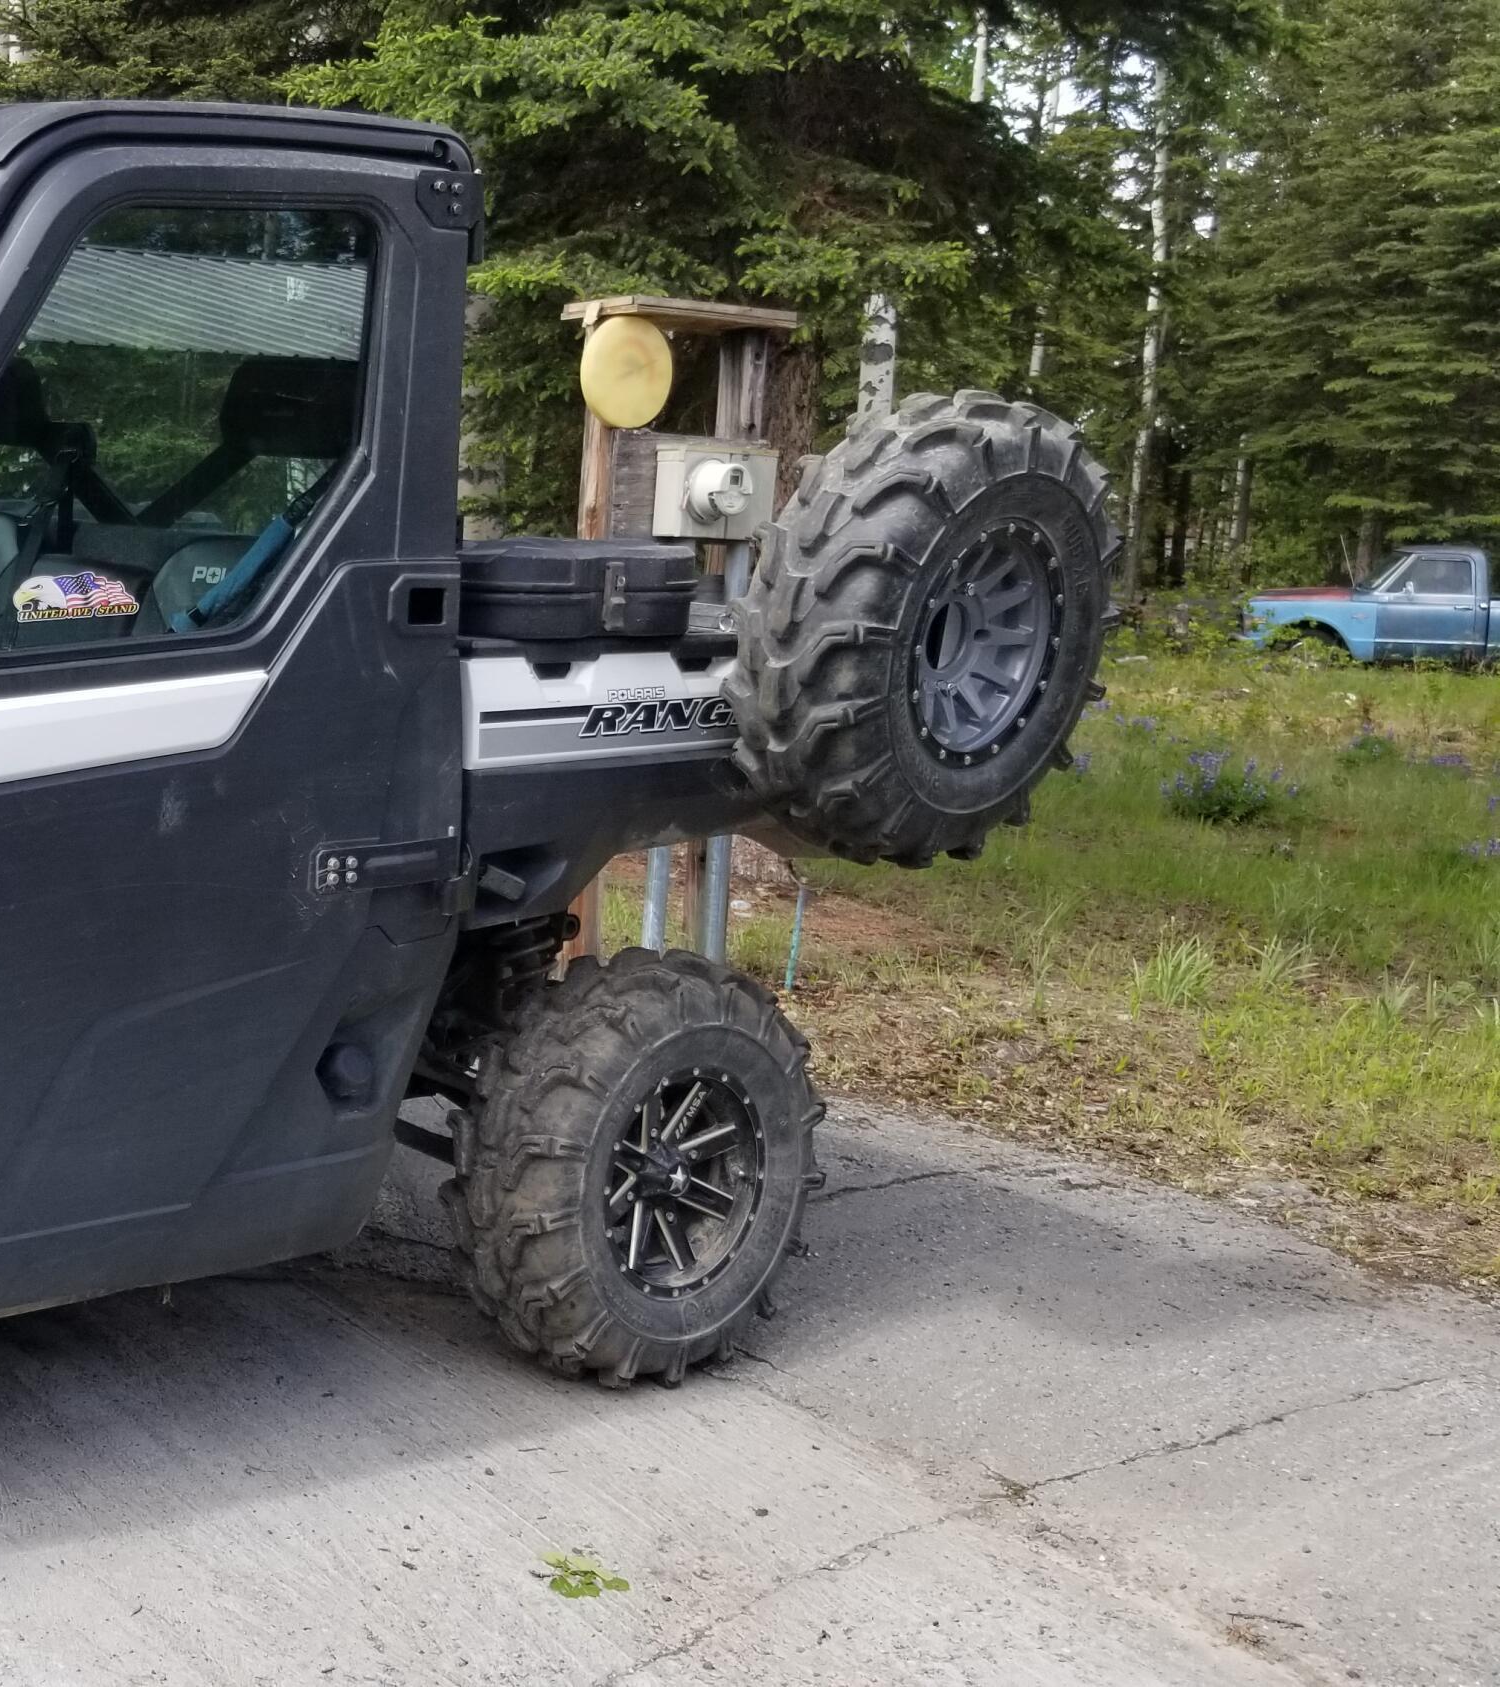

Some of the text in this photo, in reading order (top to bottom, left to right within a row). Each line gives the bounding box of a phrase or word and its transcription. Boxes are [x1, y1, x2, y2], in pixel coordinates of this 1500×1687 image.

[19, 604, 136, 620] UNITED WE STAND
[607, 686, 665, 702] POLARIS
[578, 696, 740, 739] RANG
[685, 1091, 707, 1118] MSA
